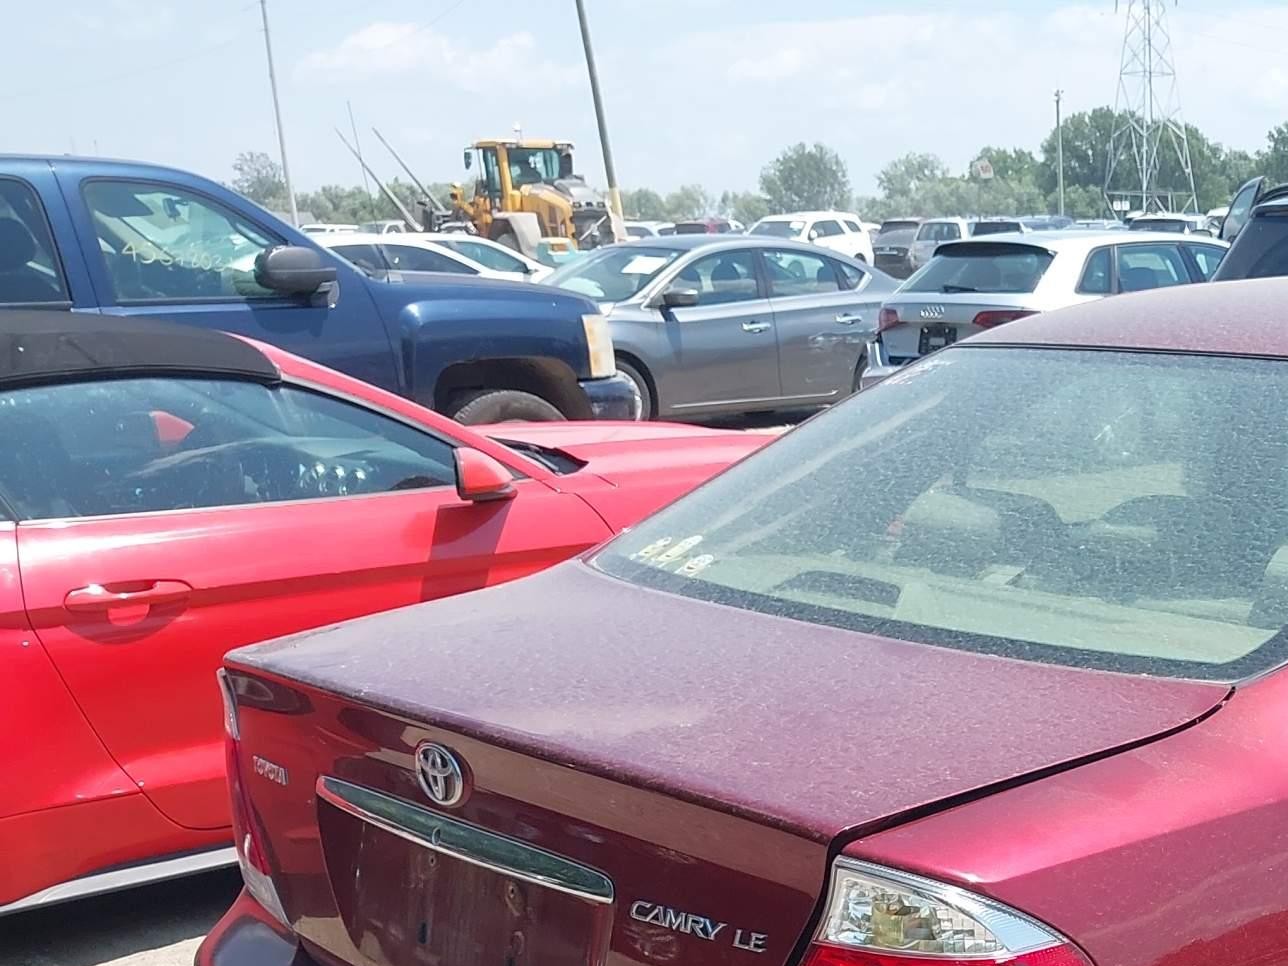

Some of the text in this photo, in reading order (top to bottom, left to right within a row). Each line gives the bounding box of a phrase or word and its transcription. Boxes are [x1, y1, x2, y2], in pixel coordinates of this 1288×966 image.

[252, 754, 289, 786] TOYOTA
[629, 899, 768, 954] CAMRY LE
